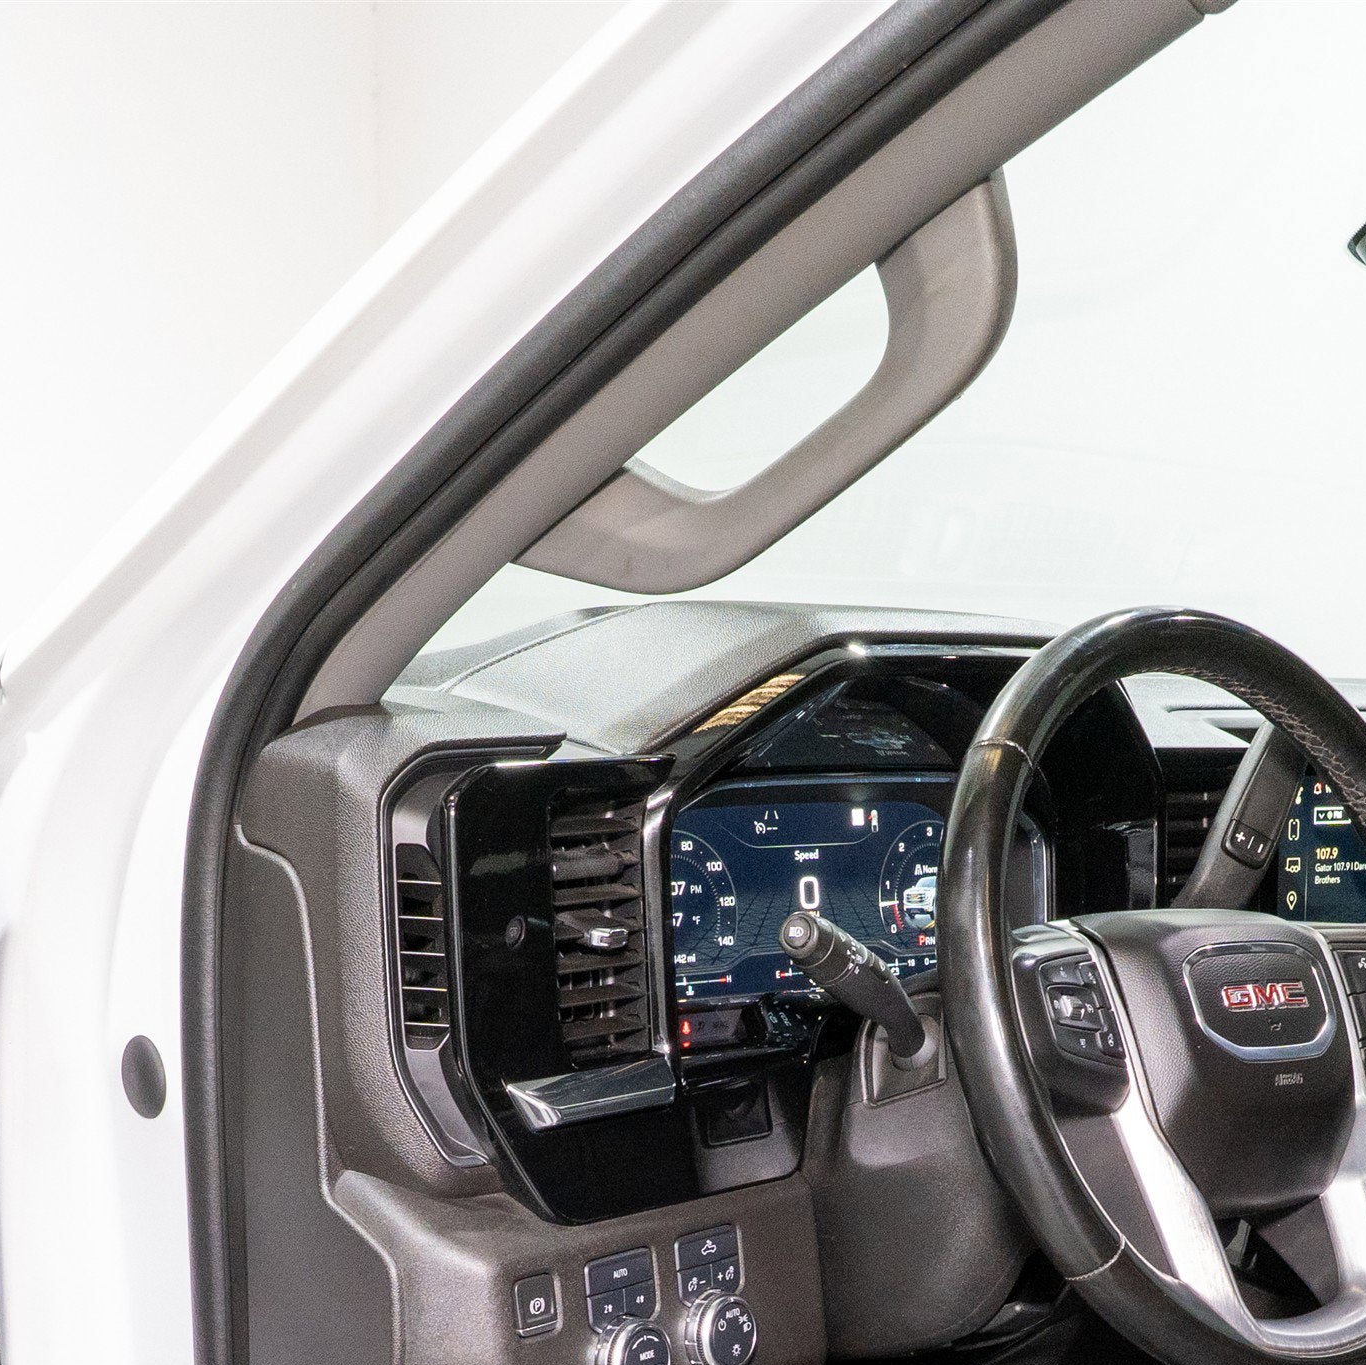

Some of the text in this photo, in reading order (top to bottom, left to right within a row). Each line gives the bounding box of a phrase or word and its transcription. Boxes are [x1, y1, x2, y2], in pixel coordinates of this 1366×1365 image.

[926, 827, 933, 837] 3
[681, 841, 693, 851] 80
[898, 843, 905, 852] 2
[794, 848, 819, 862] Speed
[1315, 847, 1338, 860] 107.9
[706, 861, 723, 871] 100
[1315, 863, 1332, 872] Gator
[1333, 861, 1350, 871] 107.9
[1315, 874, 1341, 884] Brothers
[690, 884, 702, 894] PM
[885, 880, 890, 889] 1
[799, 876, 820, 910] 0
[719, 896, 735, 906] 120
[890, 924, 897, 934] 0
[718, 936, 734, 946] 140
[674, 953, 696, 964] 42 mi
[726, 974, 732, 983] H
[775, 970, 781, 979] E
[1222, 981, 1309, 1011] GMC
[613, 1267, 628, 1279] AUTO
[725, 1307, 741, 1319] AUTO
[639, 1349, 655, 1361] MODE
